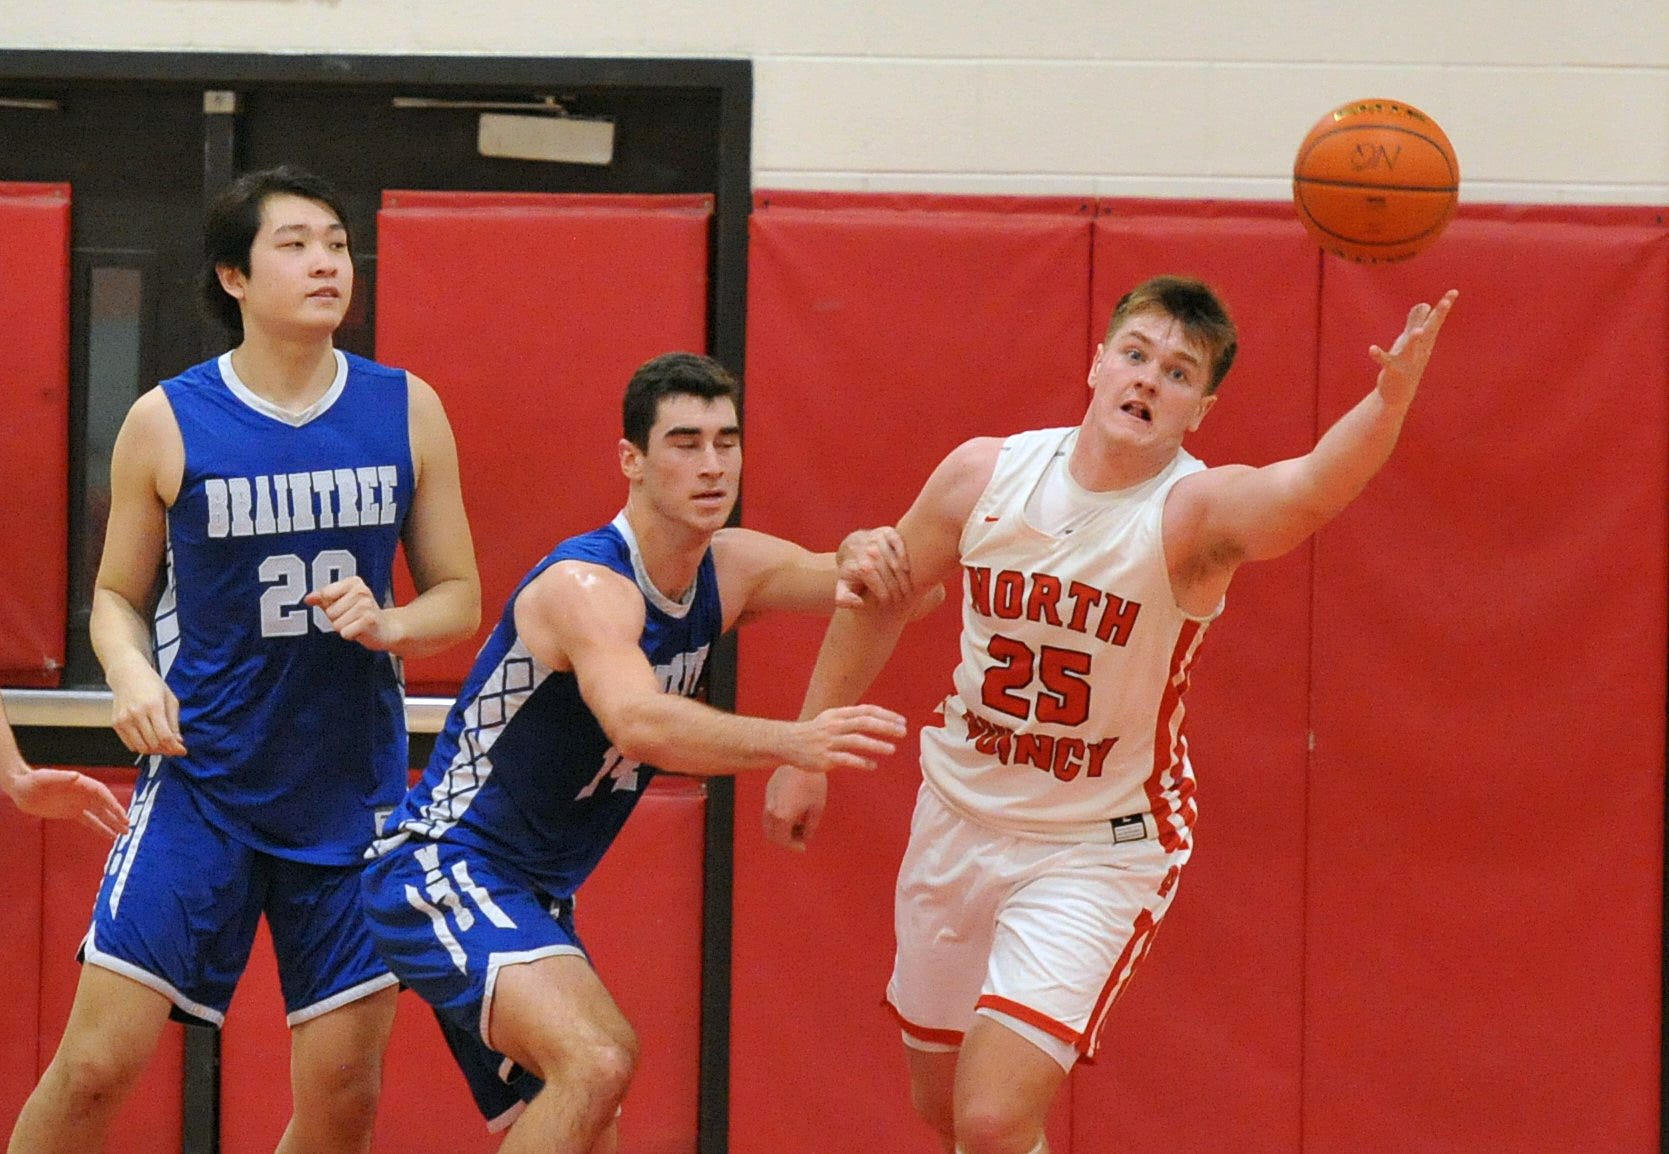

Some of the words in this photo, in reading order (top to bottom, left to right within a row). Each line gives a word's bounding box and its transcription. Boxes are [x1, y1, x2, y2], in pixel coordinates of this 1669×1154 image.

[205, 465, 397, 538] BRAINTREE
[258, 549, 356, 637] 20
[966, 566, 1141, 647] NORTH
[981, 633, 1092, 727] 25
